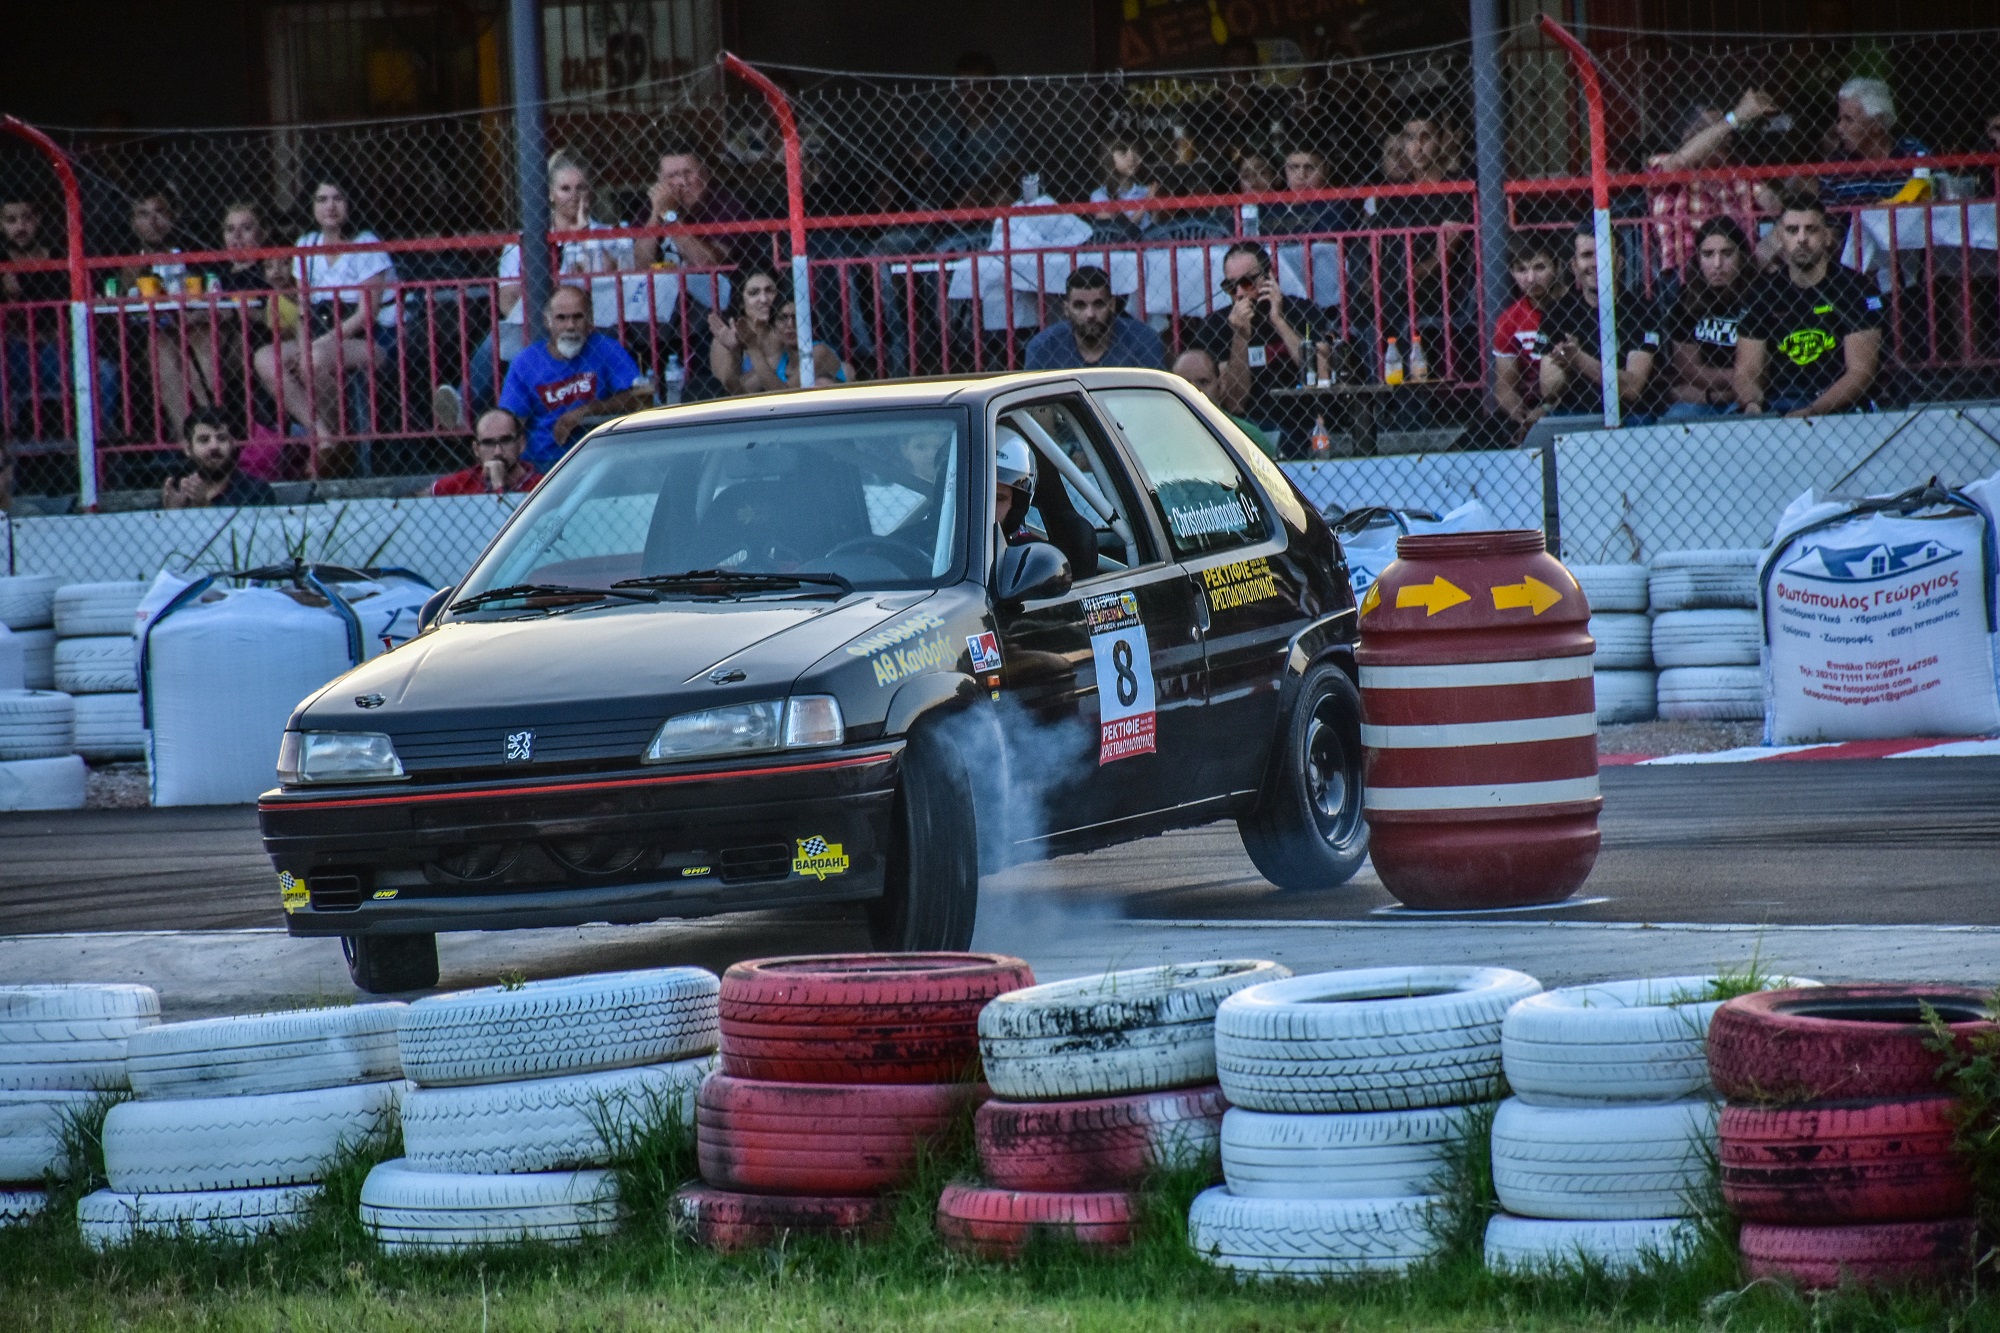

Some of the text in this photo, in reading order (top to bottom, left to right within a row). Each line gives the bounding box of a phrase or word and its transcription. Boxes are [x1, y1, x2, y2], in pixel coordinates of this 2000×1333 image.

[1202, 560, 1253, 589] ΡΕΚΤΙΦΙΕ
[1777, 571, 1959, 611] Φωτόπουλος Γεώργιος
[1113, 639, 1138, 707] 8
[1102, 718, 1140, 742] ΡΕΚΤΙΦΙΕ
[795, 857, 847, 870] BARDAHL
